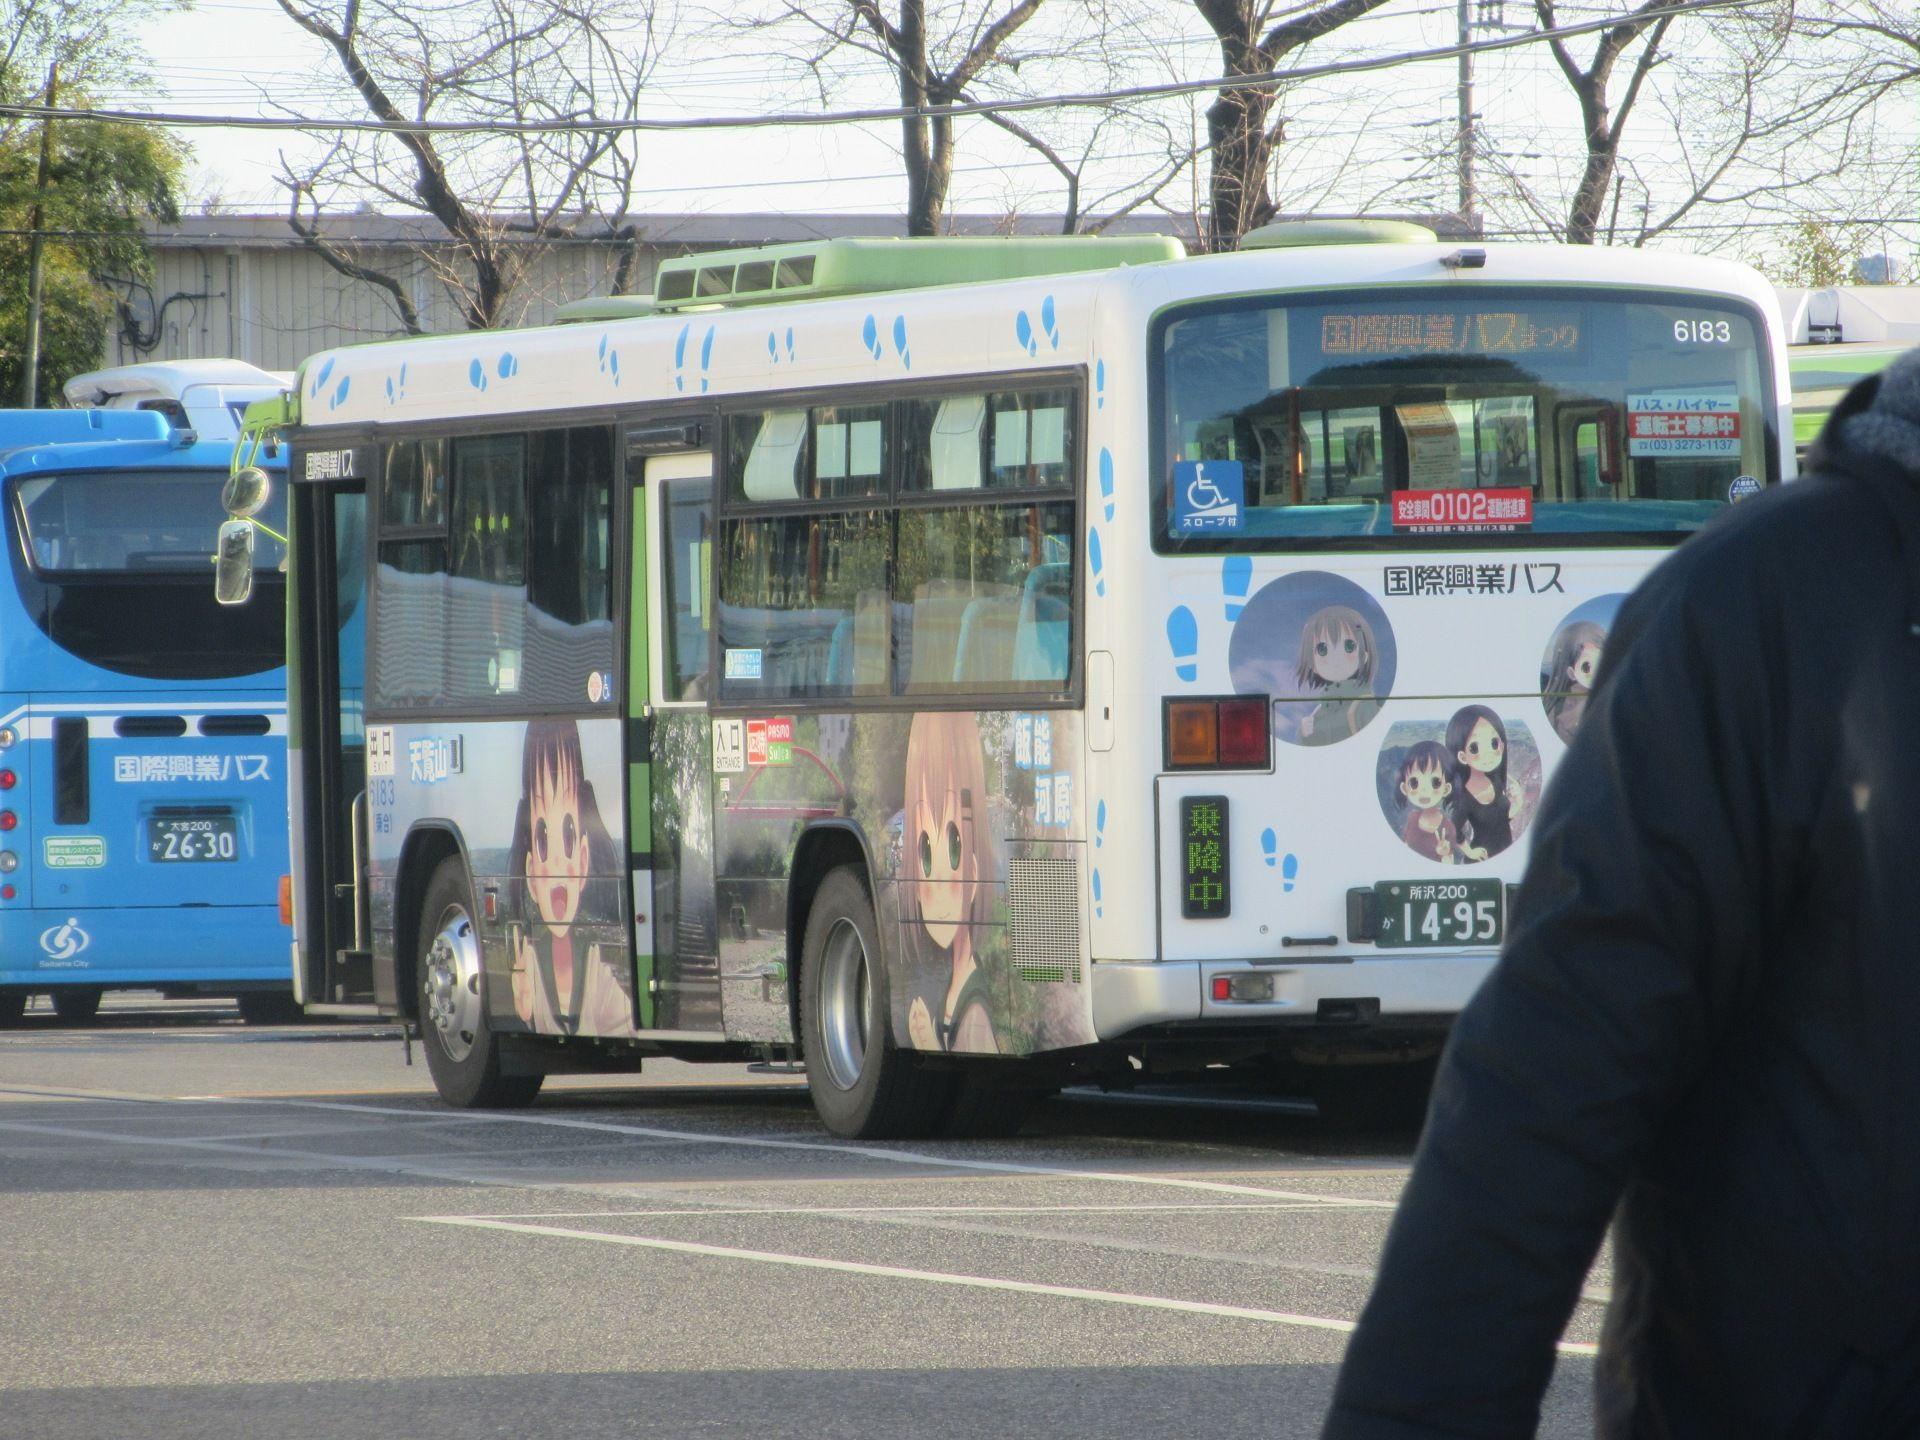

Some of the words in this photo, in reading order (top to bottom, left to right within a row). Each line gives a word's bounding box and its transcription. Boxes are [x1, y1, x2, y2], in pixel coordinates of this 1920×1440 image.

[1321, 313, 1578, 352] 国際興業バスまつり
[1674, 320, 1731, 342] 6183
[1636, 399, 1732, 411] バス・ハイヤー
[1635, 415, 1735, 436] 運転士募集中
[305, 449, 353, 480] 国際興業バス
[1183, 517, 1237, 527] スロープ付
[1384, 563, 1565, 596] 国際興業バス
[370, 729, 391, 756] 出口
[716, 723, 739, 752] 入口
[768, 725, 790, 739] PASMO
[1015, 716, 1051, 767] 飯能
[114, 754, 270, 782] 国際興業バス
[408, 738, 447, 782] 天覧山
[716, 757, 741, 769] ENTRANCE
[1035, 775, 1072, 824] 河原
[163, 832, 234, 859] 26-30
[1188, 803, 1222, 910] 乗降中
[1382, 917, 1394, 930] か
[1404, 900, 1496, 942] 14-95
